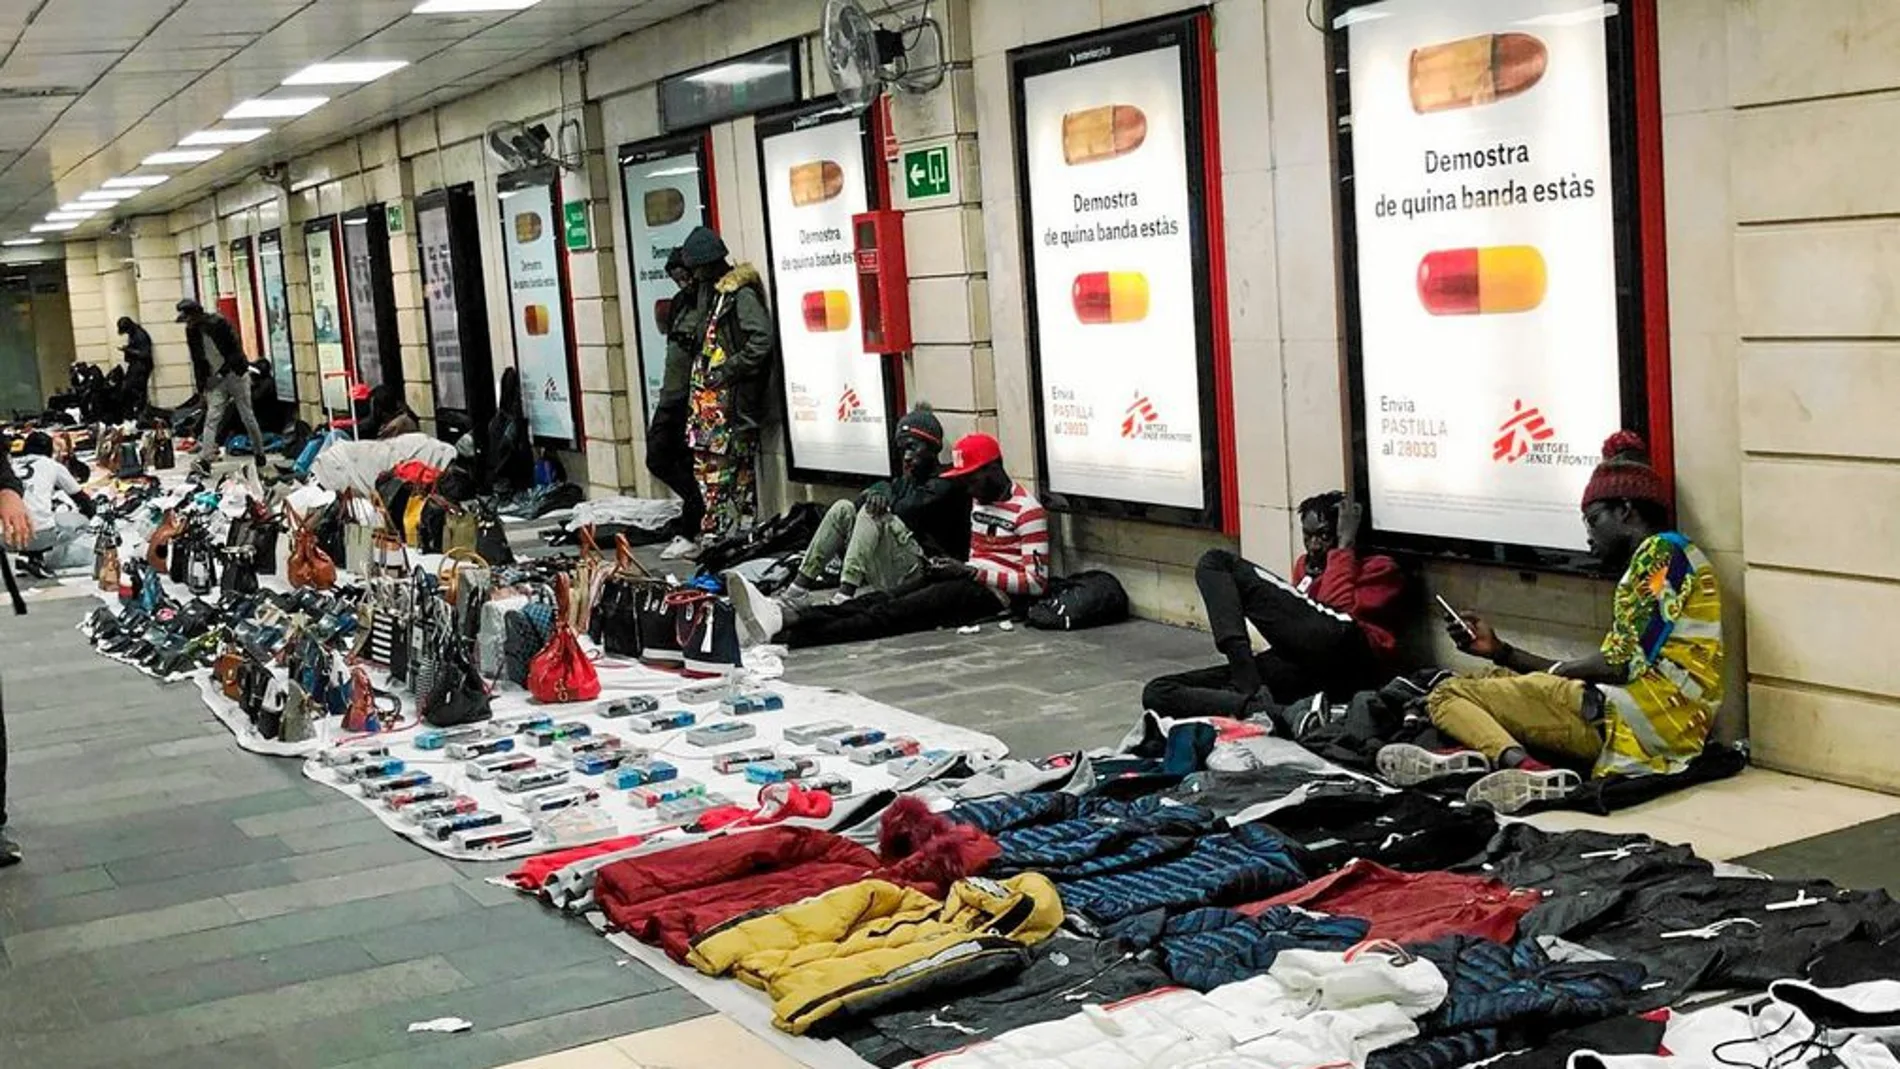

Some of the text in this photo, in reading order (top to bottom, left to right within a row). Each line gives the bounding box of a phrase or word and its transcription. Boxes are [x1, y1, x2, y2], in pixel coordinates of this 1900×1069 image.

[1425, 143, 1529, 174] Demostra
[1073, 191, 1138, 213] Demostra
[1375, 173, 1595, 220] de quina banda estàs
[1044, 227, 1058, 246] de
[1060, 223, 1095, 249] quina
[1097, 220, 1138, 241] banda
[1381, 395, 1415, 412] Envia
[1381, 418, 1448, 437] PASTILLA
[1382, 440, 1437, 458] al 28033
